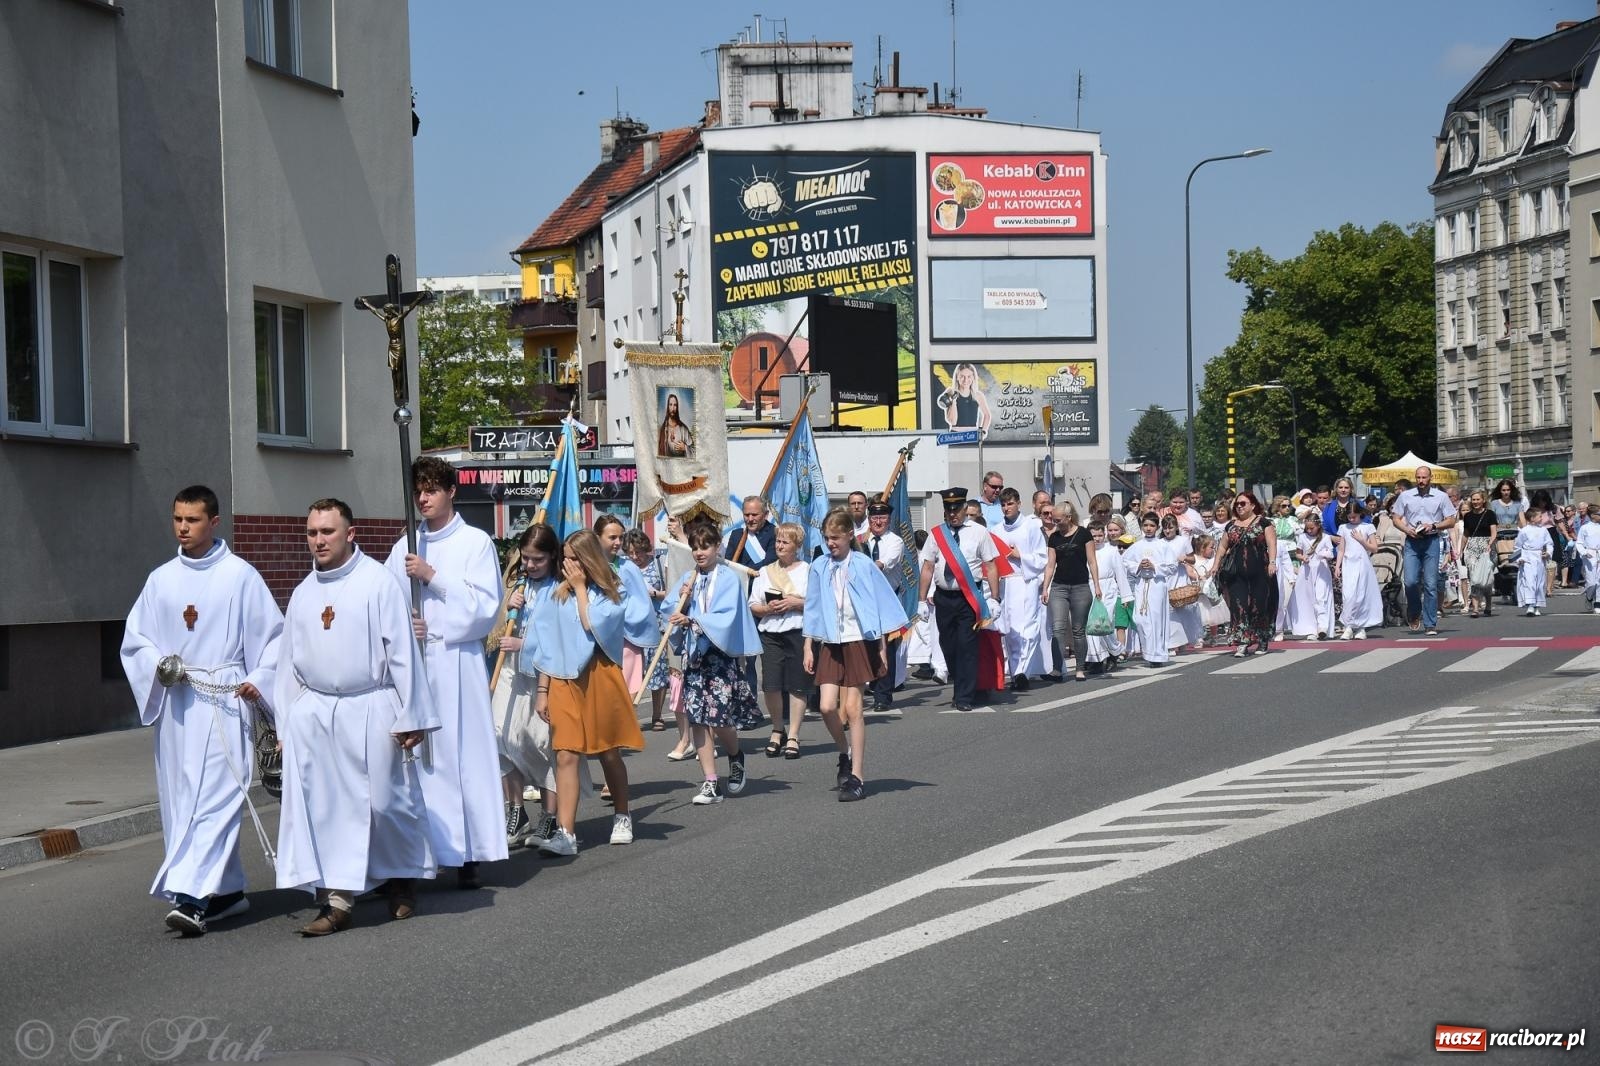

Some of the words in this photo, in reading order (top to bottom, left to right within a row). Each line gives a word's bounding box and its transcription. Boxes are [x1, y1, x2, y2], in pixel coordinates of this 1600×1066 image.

[983, 164, 1034, 178] Kebab
[1057, 164, 1085, 177] Inn
[795, 169, 870, 202] MEGAMOC
[987, 190, 1017, 198] NOWA
[1019, 189, 1082, 198] LOKALIZACJA
[987, 200, 1001, 210] ul.
[1004, 199, 1073, 210] KATOWICKA
[1074, 199, 1082, 209] 4
[1000, 217, 1071, 226] www.kebabinn.pl
[769, 236, 797, 258] 797
[801, 229, 829, 252] 817
[834, 224, 860, 247] 117
[734, 261, 769, 283] MARII
[771, 256, 805, 277] CURIE
[805, 243, 890, 272] SKŁODOWSKIEJ
[891, 239, 908, 256] 75
[725, 280, 781, 303] ZAPEWNIJ
[783, 275, 816, 293] SOBIE
[817, 266, 860, 287] CHWILĘ
[861, 257, 911, 280] RELAKSU
[475, 431, 557, 449] TRAFIKA
[458, 470, 478, 485] MY
[479, 470, 522, 485] WIEMY
[590, 468, 618, 483] JARA
